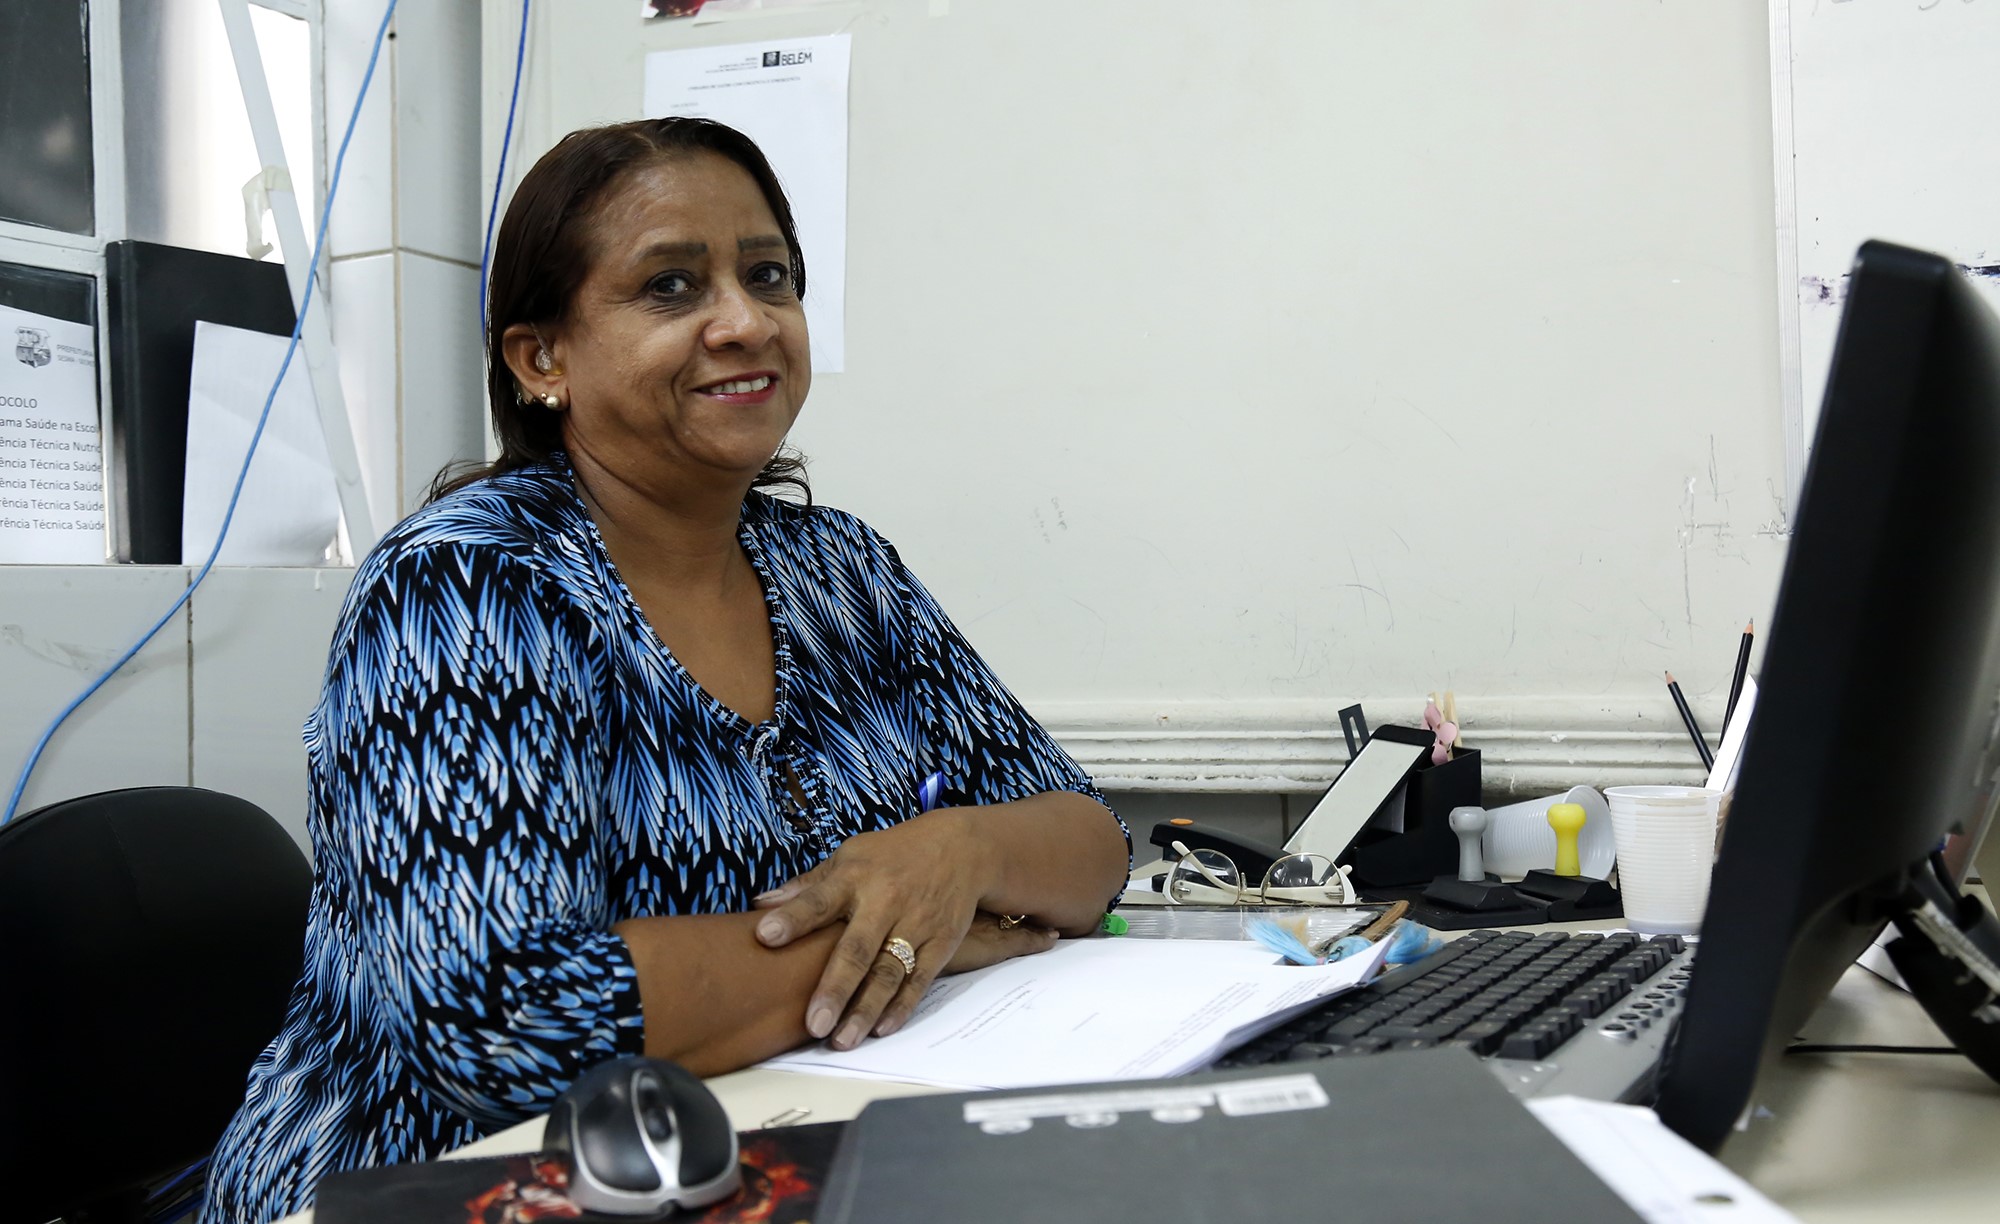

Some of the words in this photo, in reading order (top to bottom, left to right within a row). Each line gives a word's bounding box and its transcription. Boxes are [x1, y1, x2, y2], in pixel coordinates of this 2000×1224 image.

[781, 52, 813, 66] BELÉM
[0, 396, 38, 409] OCOLO
[0, 418, 22, 428] ama
[25, 418, 58, 430] Saúde
[60, 422, 73, 431] na
[30, 438, 70, 451] Técnica
[30, 458, 70, 471] Técnica
[73, 460, 102, 473] Saúde
[30, 478, 70, 491] Técnica
[73, 480, 103, 492] Saúde
[31, 499, 71, 511] Técnica
[73, 500, 105, 512] Saúde
[33, 519, 73, 531] Técnica
